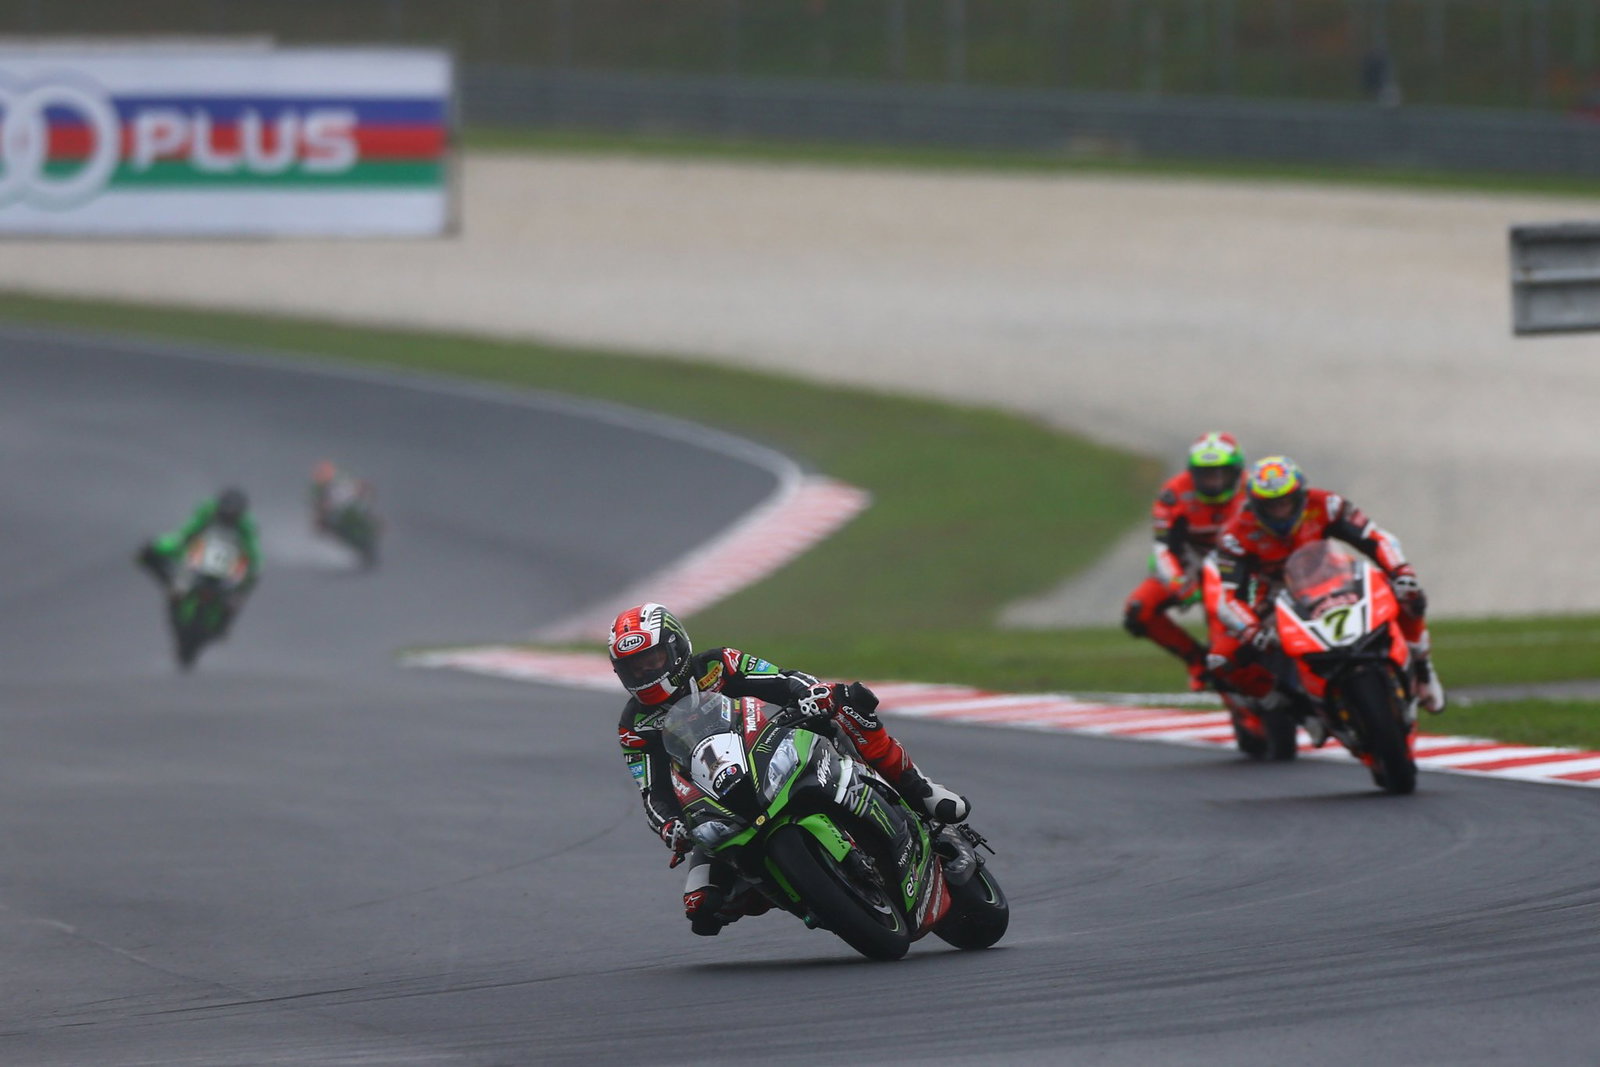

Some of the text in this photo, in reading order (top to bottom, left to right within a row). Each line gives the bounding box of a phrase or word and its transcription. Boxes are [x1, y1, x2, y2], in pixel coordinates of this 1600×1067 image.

[131, 106, 359, 174] PLUS
[619, 635, 642, 649] Arai
[1324, 606, 1351, 642] 7
[700, 743, 719, 781] 1
[715, 770, 727, 789] elf
